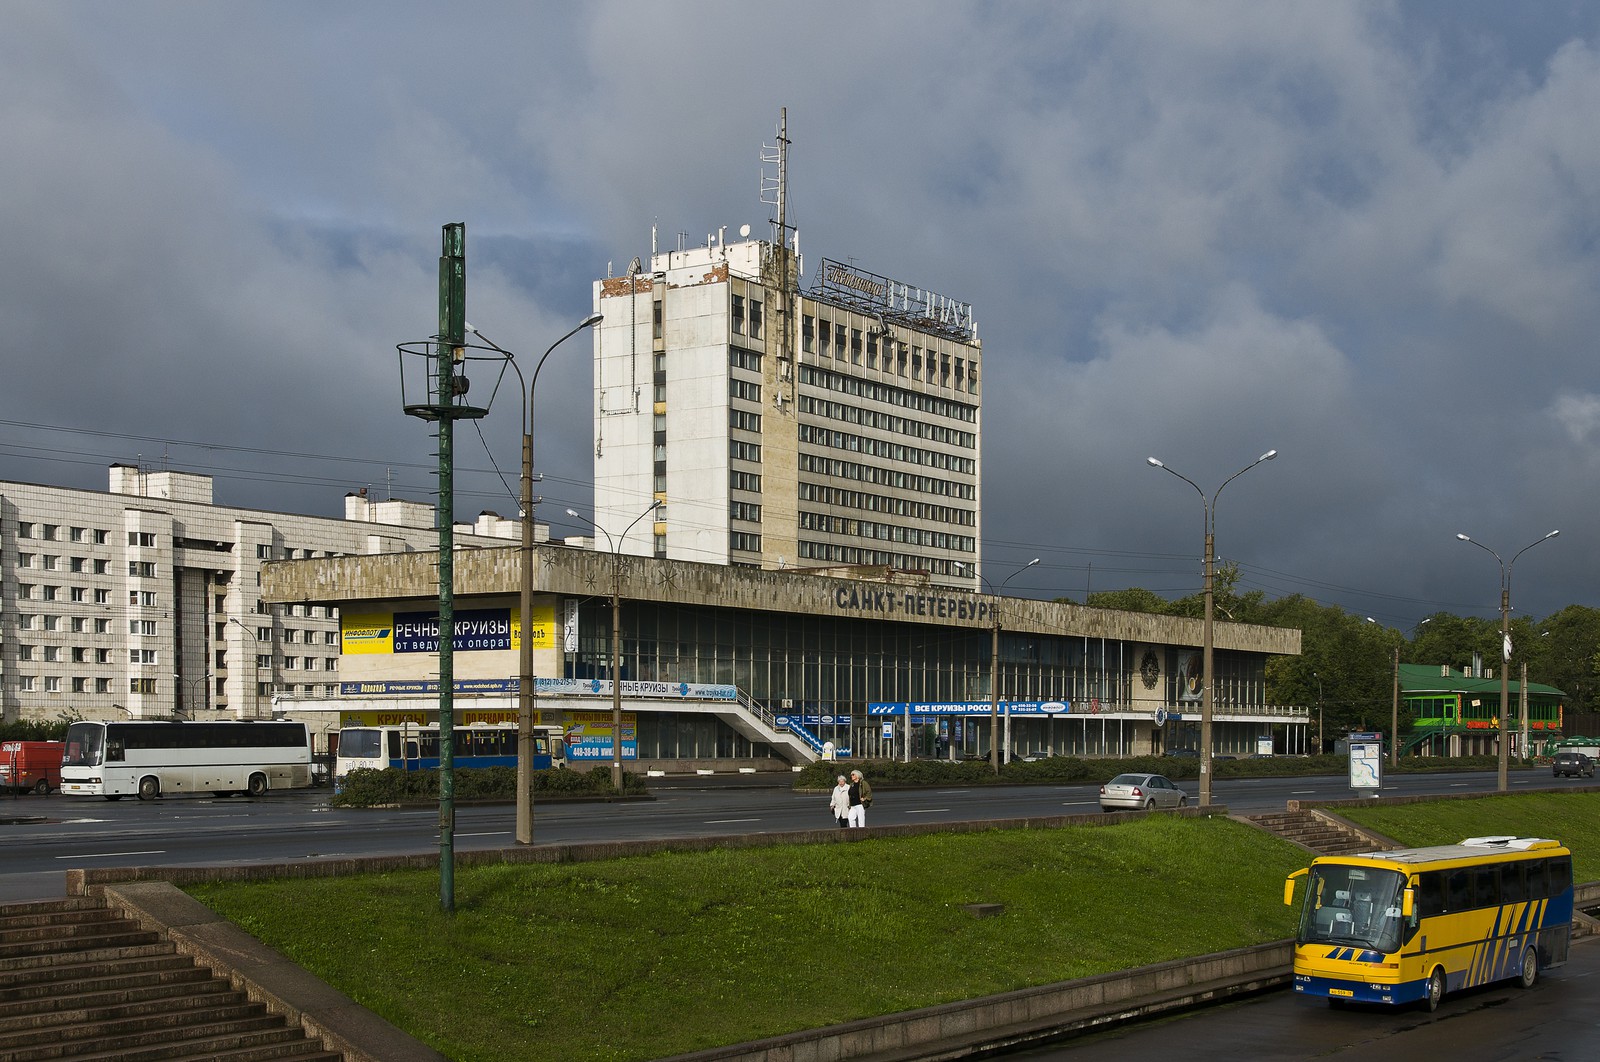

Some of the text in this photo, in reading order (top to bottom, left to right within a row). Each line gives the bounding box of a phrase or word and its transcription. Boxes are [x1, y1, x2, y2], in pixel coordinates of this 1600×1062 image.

[396, 620, 508, 637] РЕЧНЫ КРУИЗЫ
[396, 641, 408, 650] от
[413, 639, 463, 651] ведуих
[377, 714, 425, 725] КРУИЗЫ
[466, 713, 476, 724] ПО
[478, 713, 504, 723] РЕКАМ
